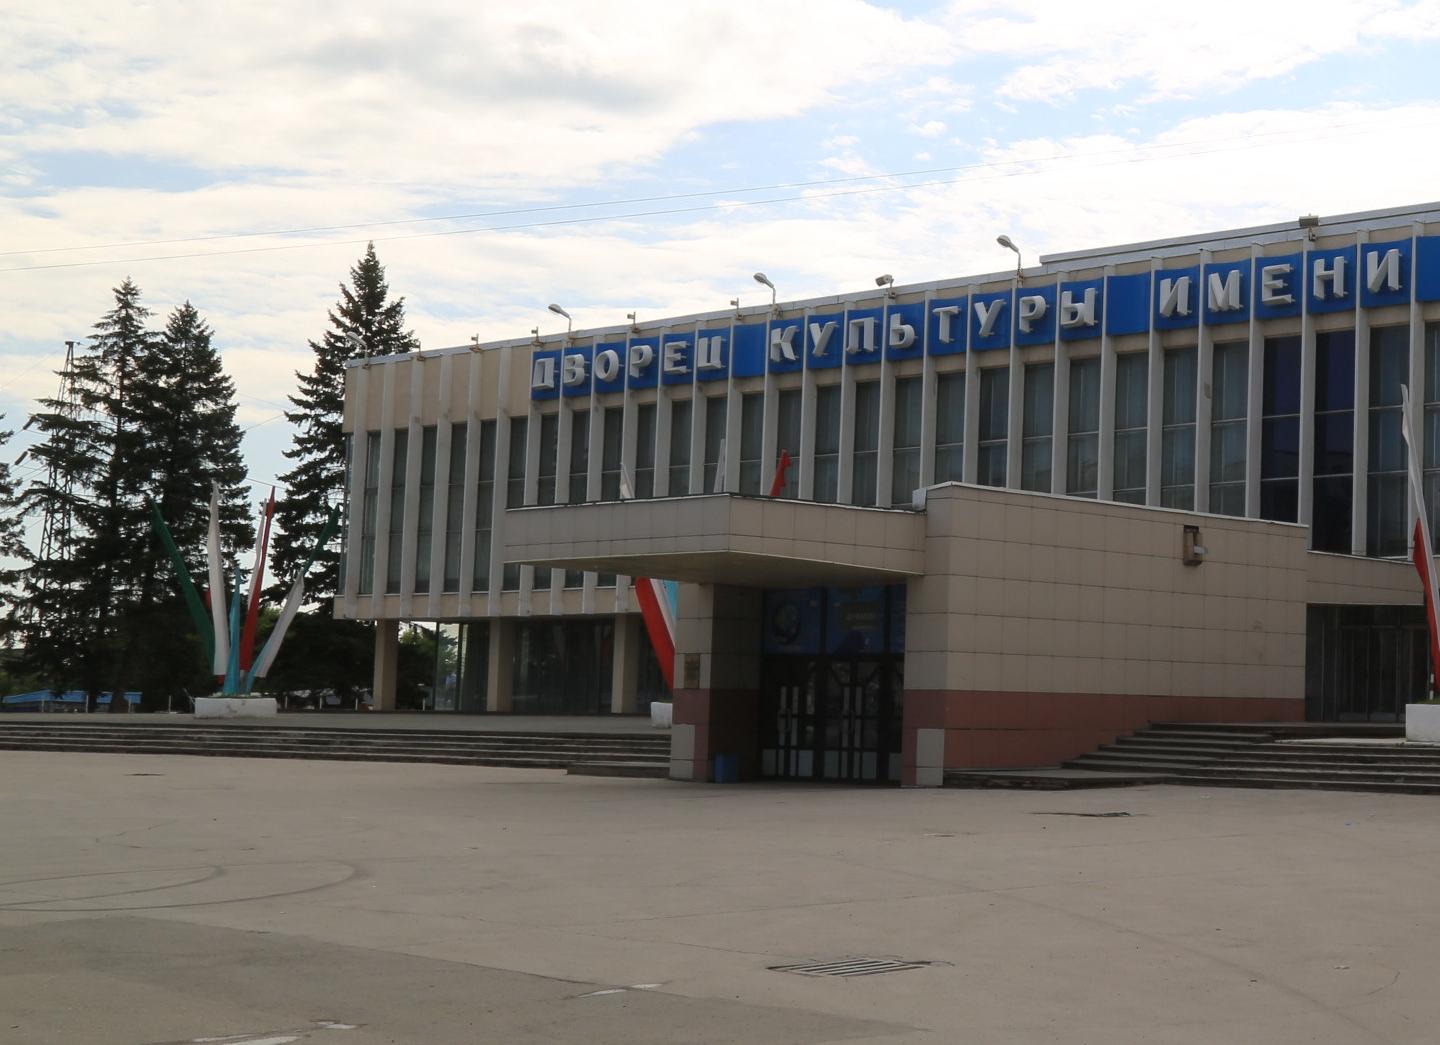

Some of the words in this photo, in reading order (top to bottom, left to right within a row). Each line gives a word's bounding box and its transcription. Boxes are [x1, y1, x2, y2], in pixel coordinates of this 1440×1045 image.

[531, 335, 724, 391] ДВОРЕЦ
[770, 286, 1097, 362] КУЛЬТУРЫ
[1158, 248, 1402, 317] ИМЕНИ
